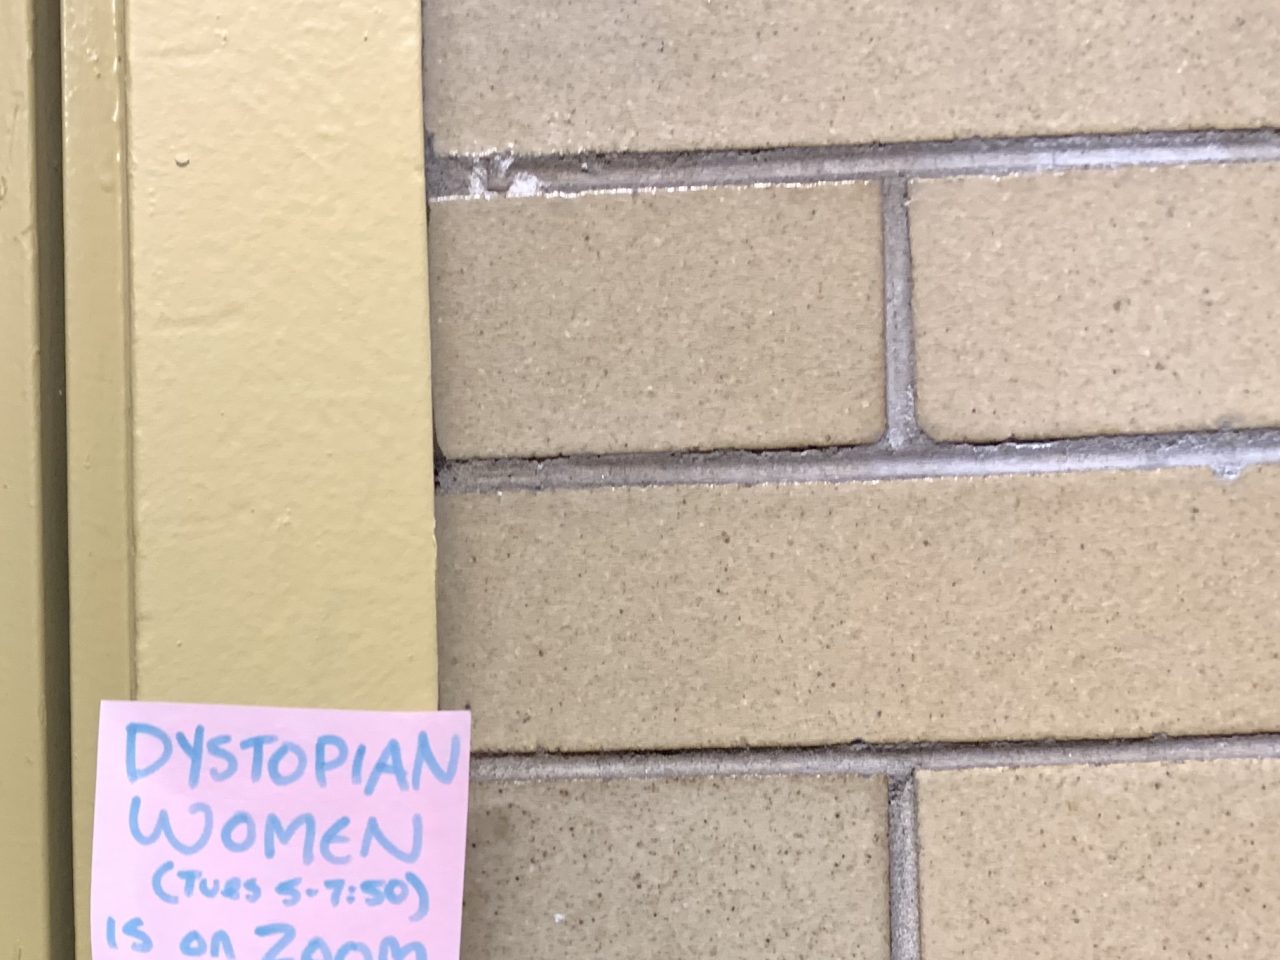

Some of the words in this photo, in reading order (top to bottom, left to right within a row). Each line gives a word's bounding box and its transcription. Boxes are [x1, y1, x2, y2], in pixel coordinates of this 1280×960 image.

[125, 721, 461, 796] DYSTOPIAN
[128, 795, 423, 865] WOMEN
[179, 929, 235, 960] on
